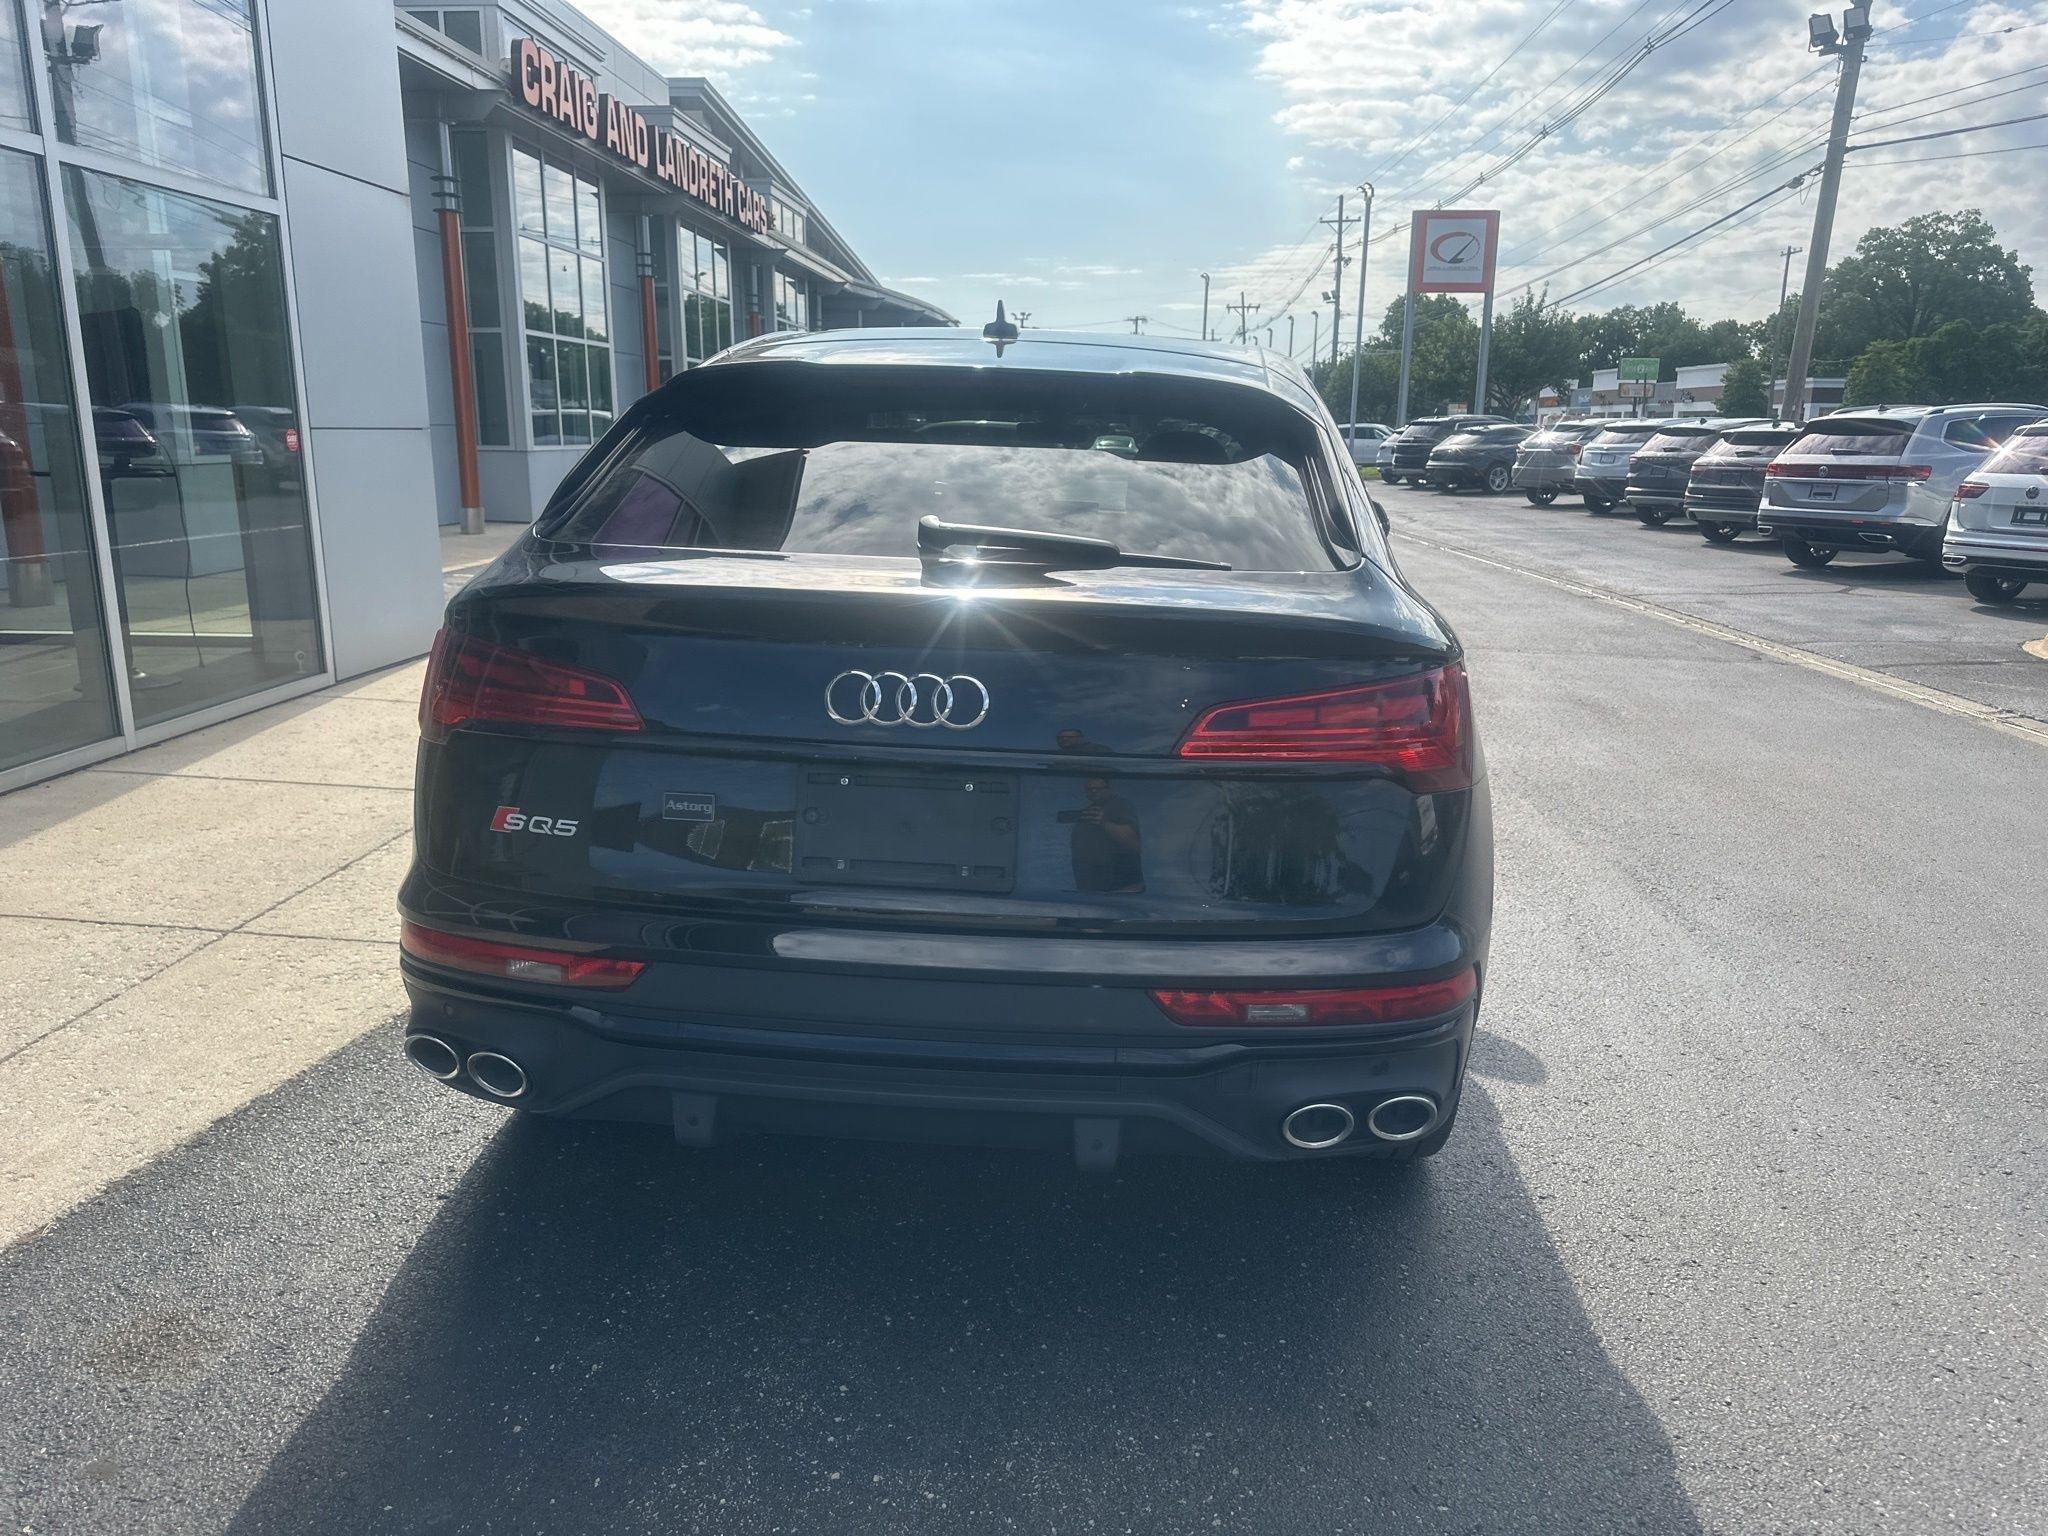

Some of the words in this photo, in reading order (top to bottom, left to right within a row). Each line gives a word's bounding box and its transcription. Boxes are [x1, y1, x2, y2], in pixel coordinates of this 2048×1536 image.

[516, 38, 598, 140] CRAIG
[604, 93, 648, 168] AND
[654, 125, 734, 217] LANDRETH
[736, 181, 768, 236] CARS
[666, 799, 713, 815] Astorg
[503, 813, 579, 837] SQ5
